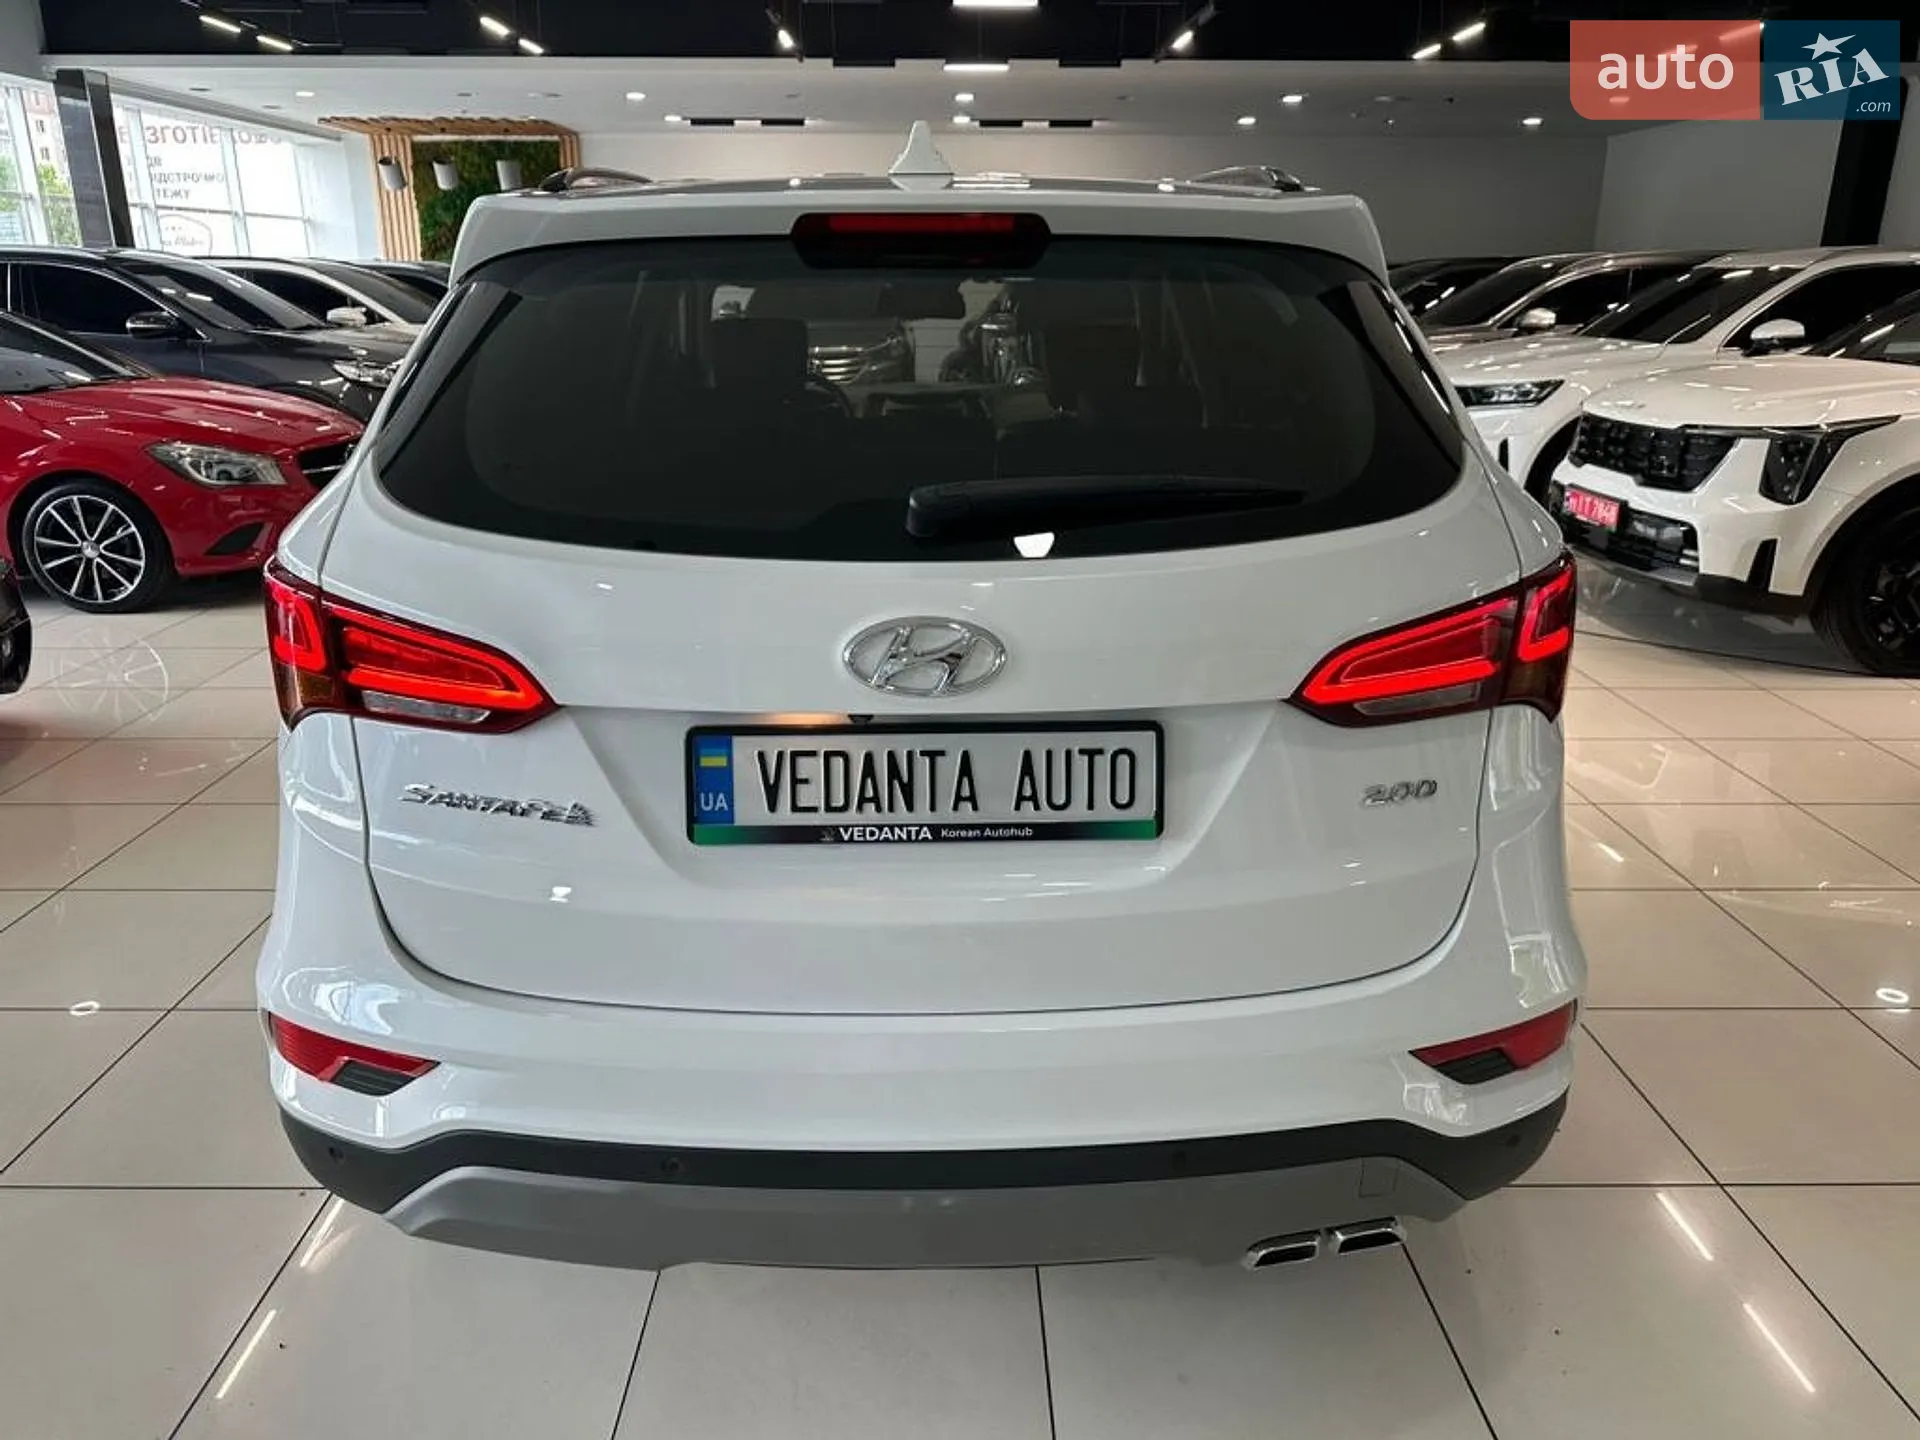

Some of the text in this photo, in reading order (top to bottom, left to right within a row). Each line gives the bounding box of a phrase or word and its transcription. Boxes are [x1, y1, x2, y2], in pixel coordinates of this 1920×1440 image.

[756, 747, 1137, 814] VEDANTA AUTO
[700, 793, 728, 812] UA
[839, 826, 1034, 842] VEDANTA Korean Autohub
